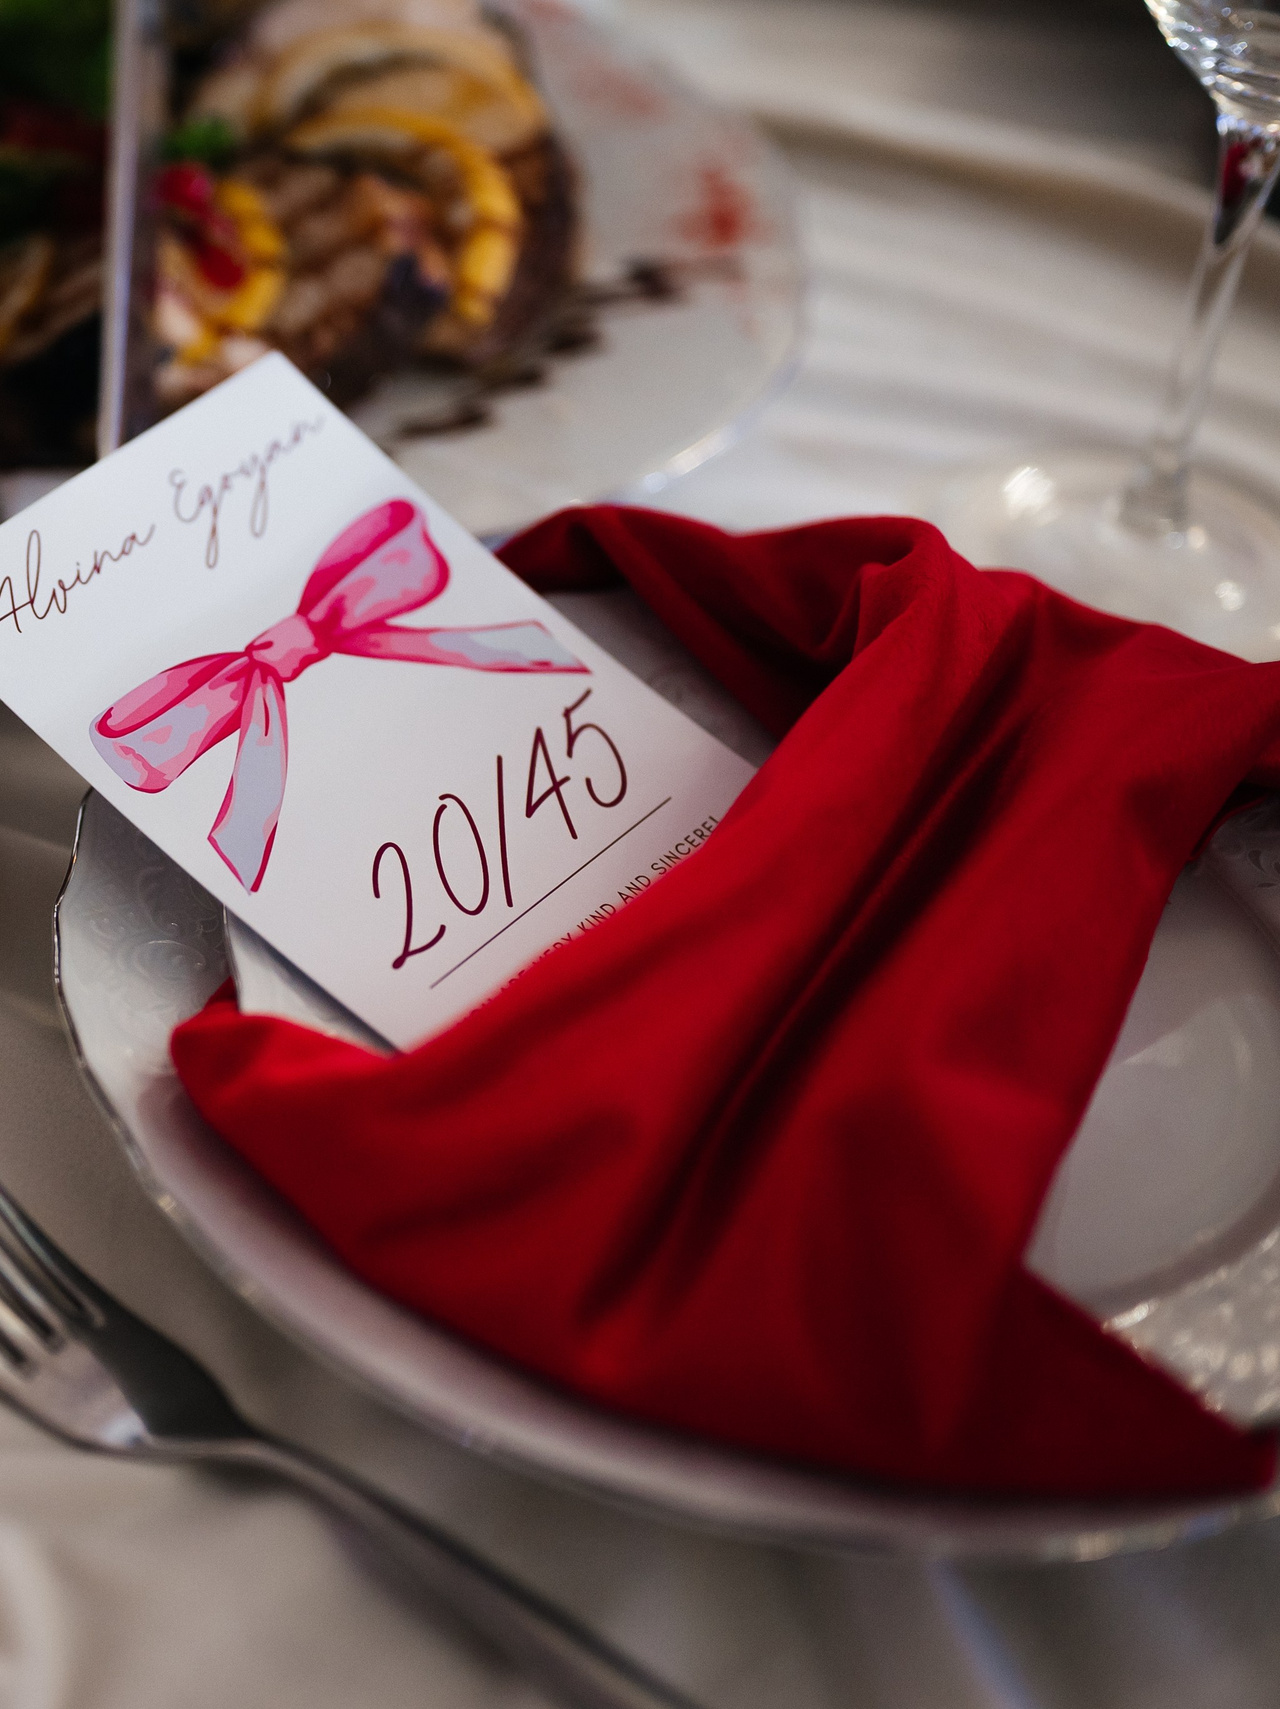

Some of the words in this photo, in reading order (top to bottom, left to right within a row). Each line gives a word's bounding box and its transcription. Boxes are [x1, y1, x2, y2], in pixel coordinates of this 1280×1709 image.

[371, 687, 628, 970] 20/45
[576, 903, 617, 933] KIND
[617, 875, 652, 905] AND
